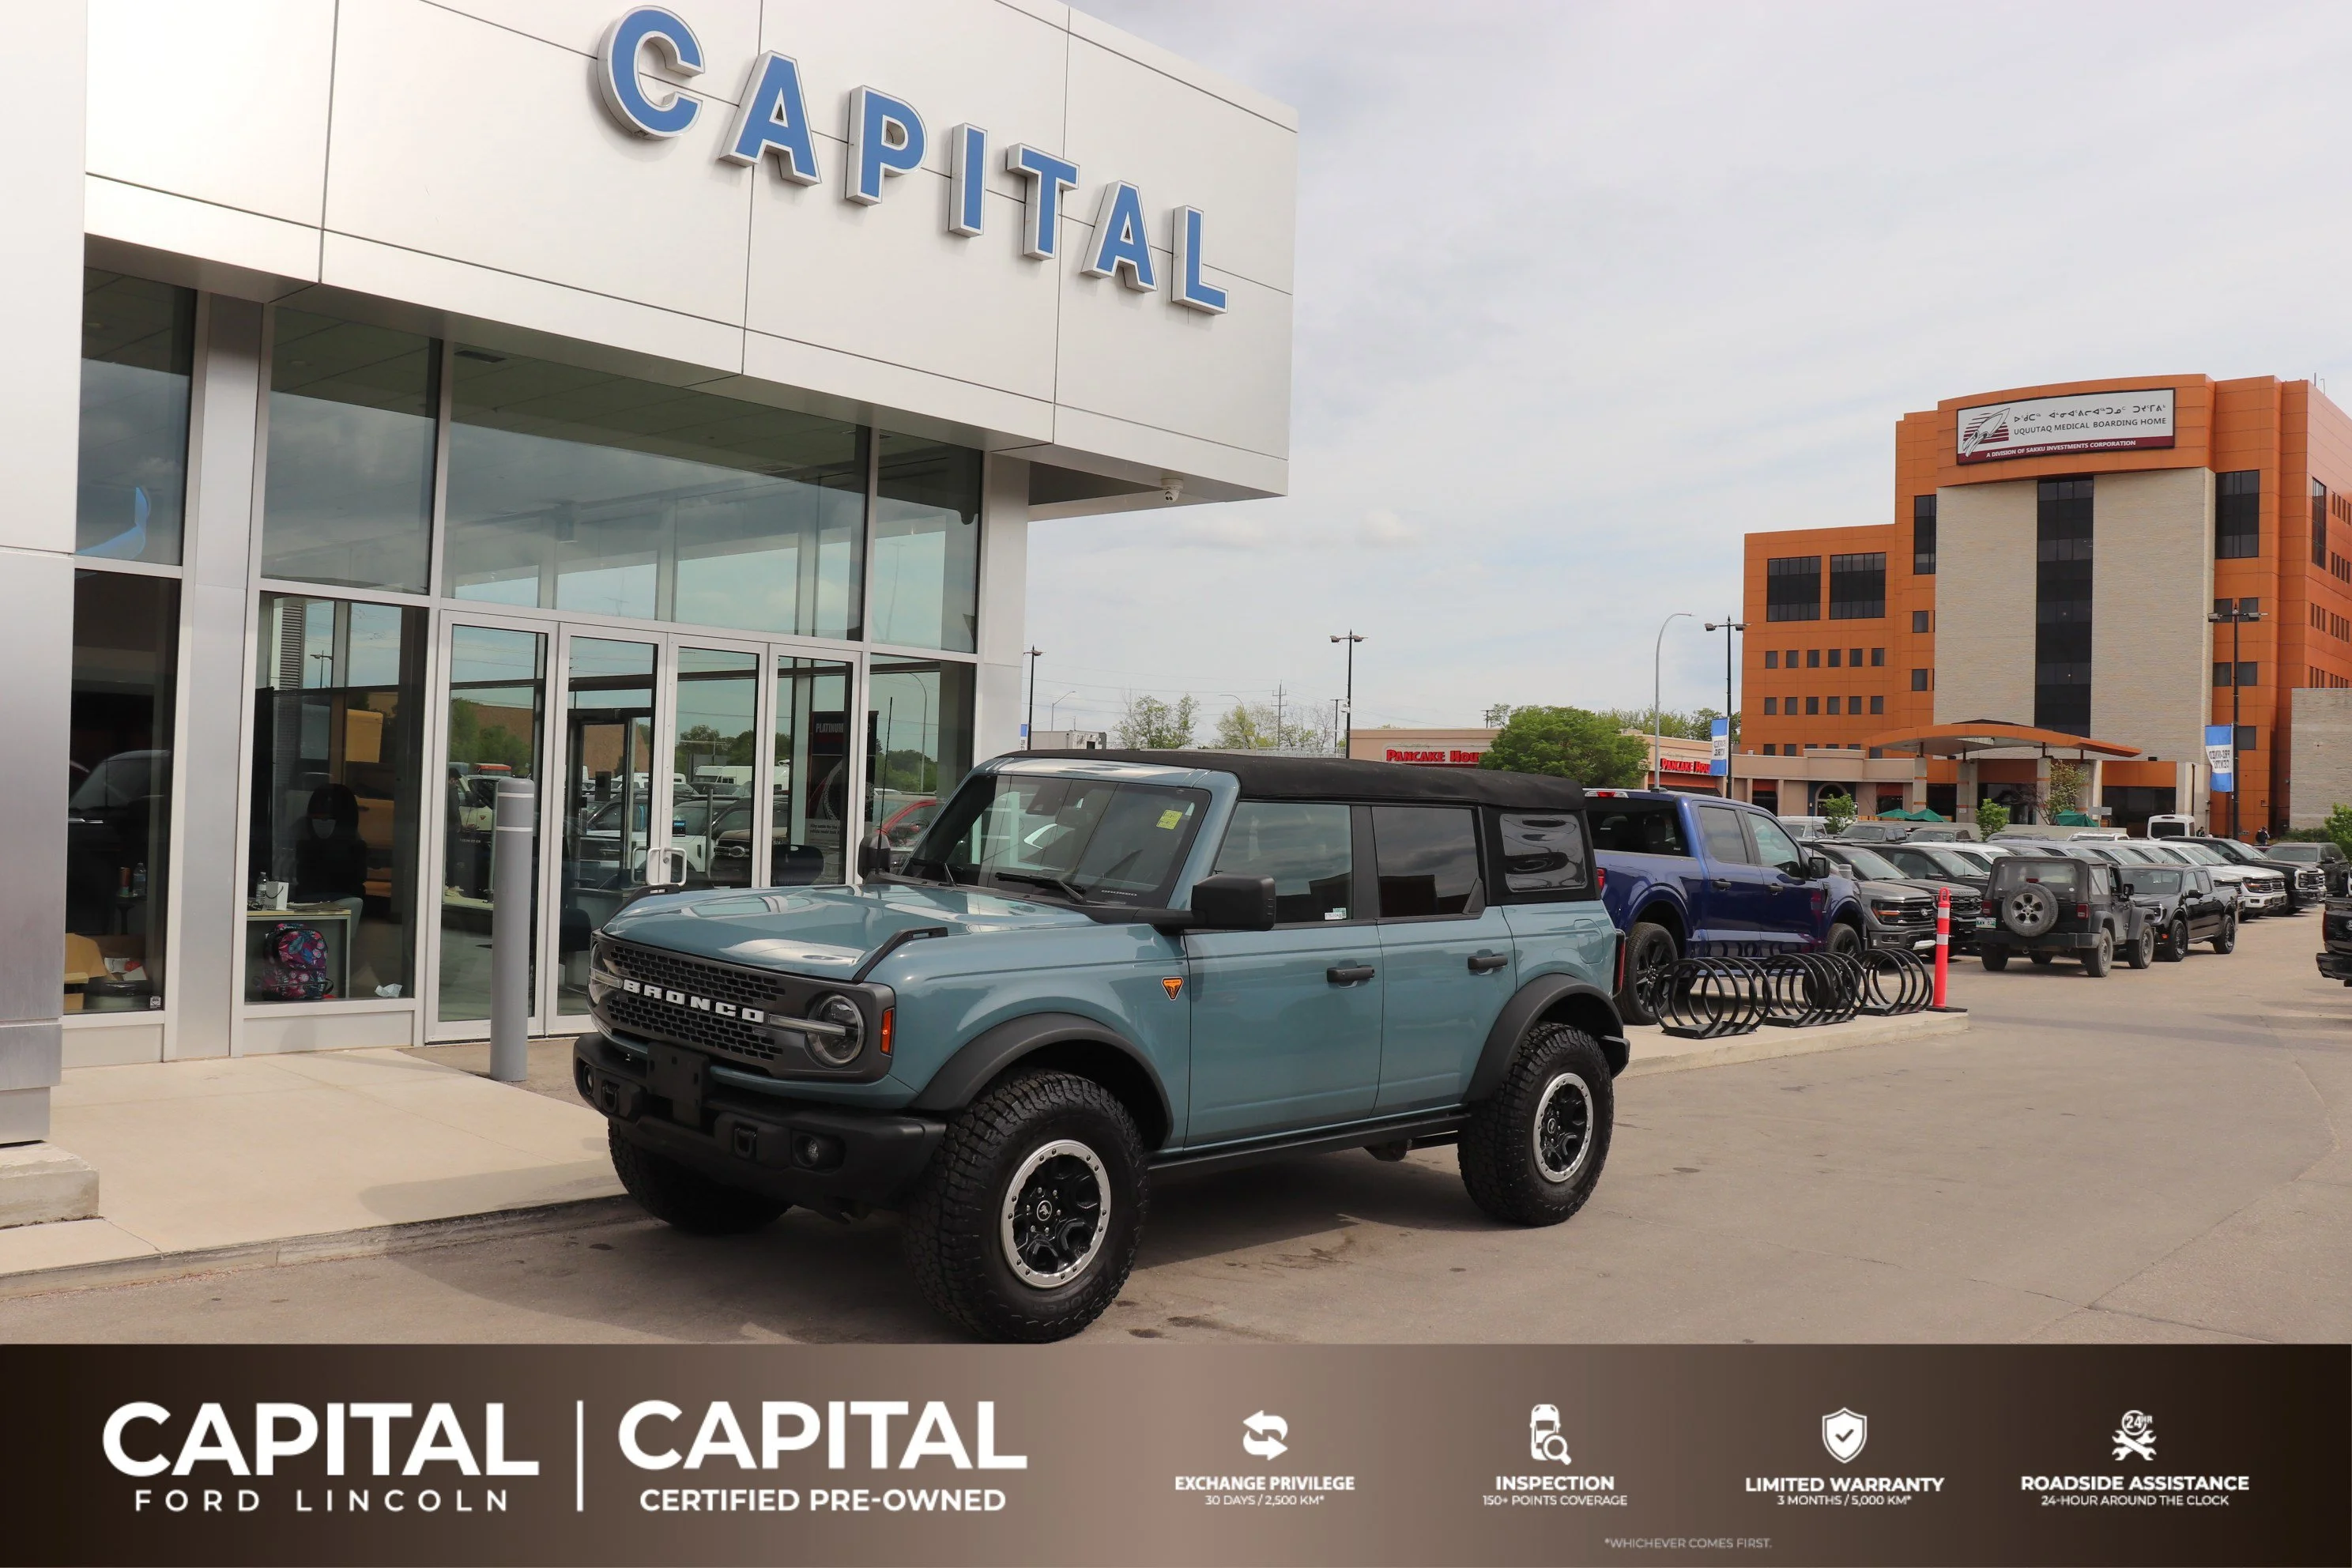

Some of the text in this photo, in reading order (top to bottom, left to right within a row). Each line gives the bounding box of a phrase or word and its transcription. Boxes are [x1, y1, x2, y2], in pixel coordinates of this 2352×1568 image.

[598, 6, 1229, 315] CAPITAL
[2014, 425, 2052, 435] UQUUTAQ
[2054, 422, 2090, 432] MEDICAL
[2093, 419, 2138, 428] BOARDING
[1992, 449, 2016, 458] DIVISION
[2046, 443, 2089, 451] INVESTMENTS
[816, 722, 844, 733] PLATINUM
[1386, 749, 1446, 762] PANCAKE
[624, 979, 764, 1023] BRONCO
